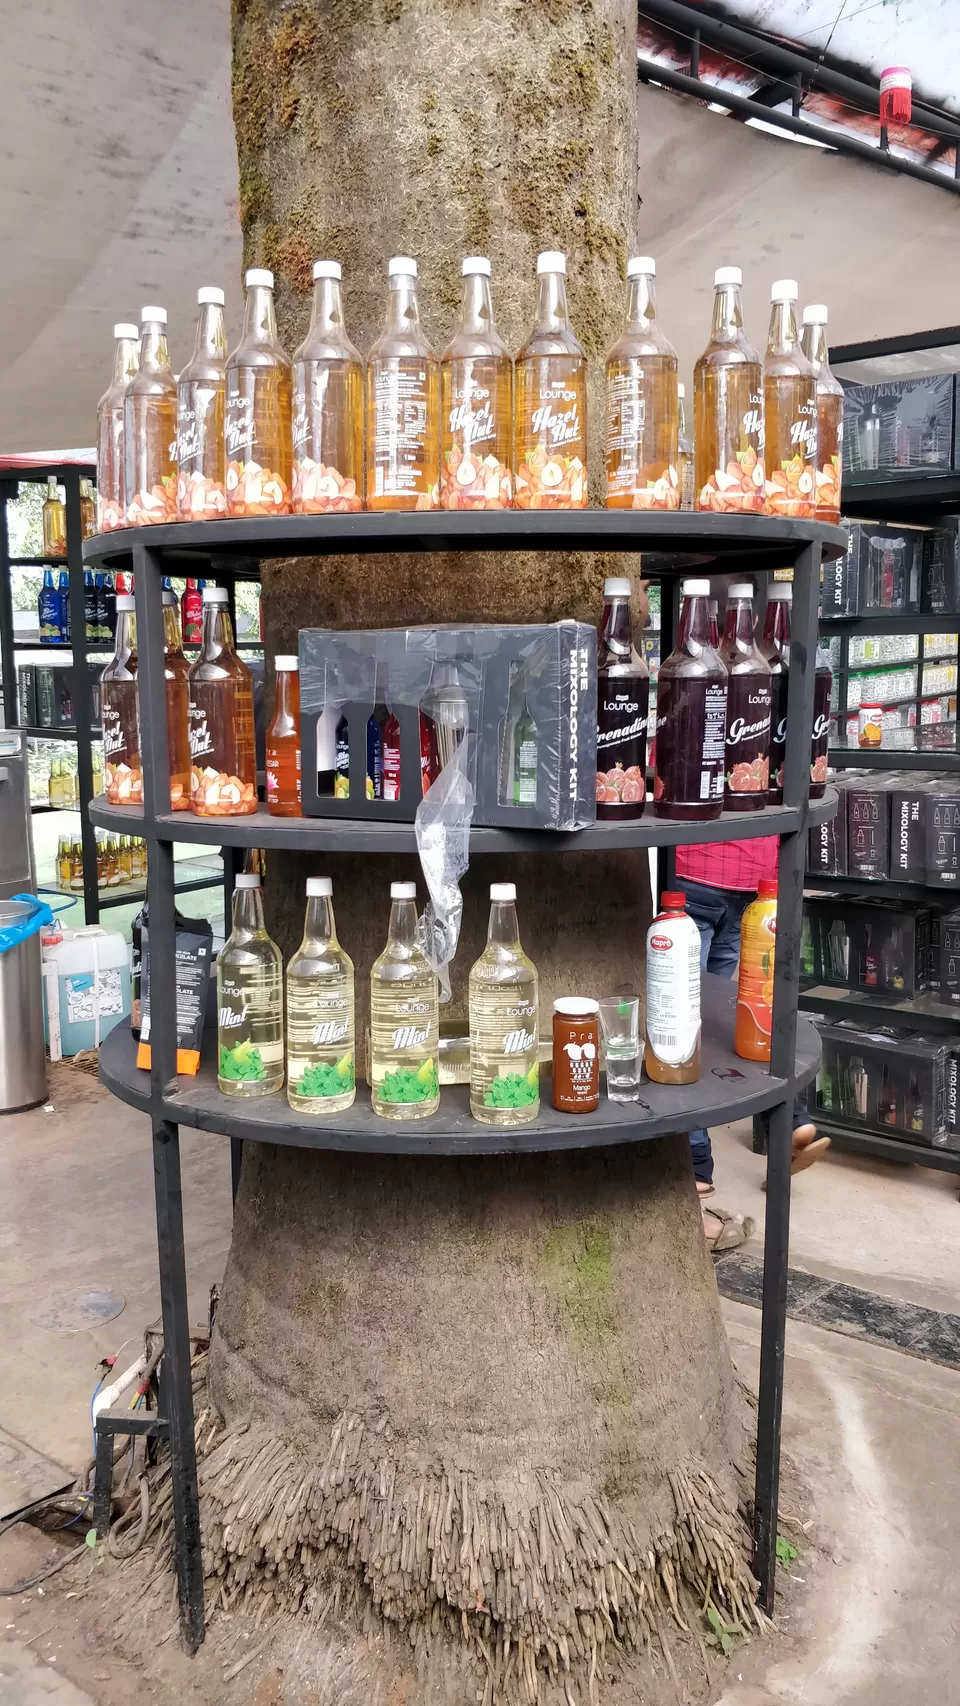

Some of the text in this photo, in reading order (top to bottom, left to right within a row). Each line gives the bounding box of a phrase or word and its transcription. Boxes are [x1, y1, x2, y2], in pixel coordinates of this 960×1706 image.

[540, 388, 577, 401] Lounge
[531, 403, 577, 433] Hazel
[551, 417, 580, 442] Nut
[580, 648, 588, 691] THE
[604, 700, 639, 713] Lounge
[569, 649, 577, 800] MIXOLOGY KIT
[911, 801, 920, 820] THE
[900, 801, 909, 852] MIXOLOGY
[820, 848, 828, 864] KIT
[219, 1004, 249, 1027] Mint
[315, 998, 348, 1009] Lounge
[395, 1003, 430, 1013] Lounge
[506, 1005, 536, 1017] Lounge
[311, 1015, 349, 1045] Mint
[391, 1020, 431, 1050] Mint
[502, 1022, 537, 1055] Mint
[572, 1084, 591, 1092] Mango
[949, 1059, 957, 1107] MIXOLOGY
